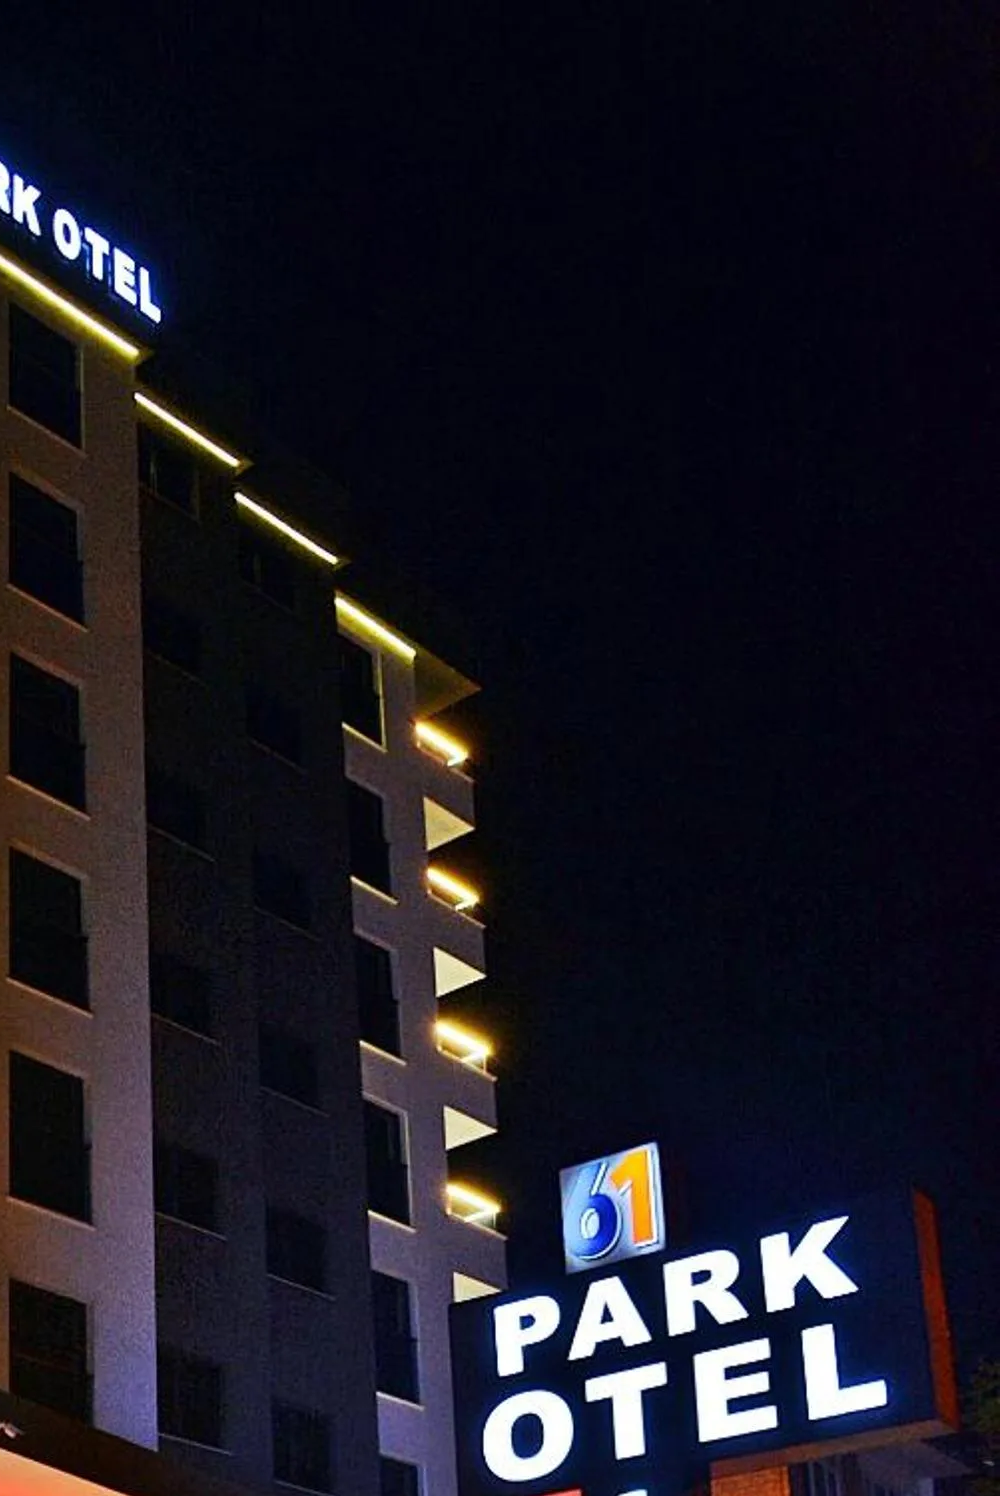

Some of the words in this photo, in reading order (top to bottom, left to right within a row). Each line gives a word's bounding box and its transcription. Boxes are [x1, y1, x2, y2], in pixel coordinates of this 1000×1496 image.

[53, 207, 162, 325] OTEL
[565, 1143, 661, 1263] 61
[492, 1214, 860, 1378] PARK
[482, 1322, 889, 1483] OTEL
